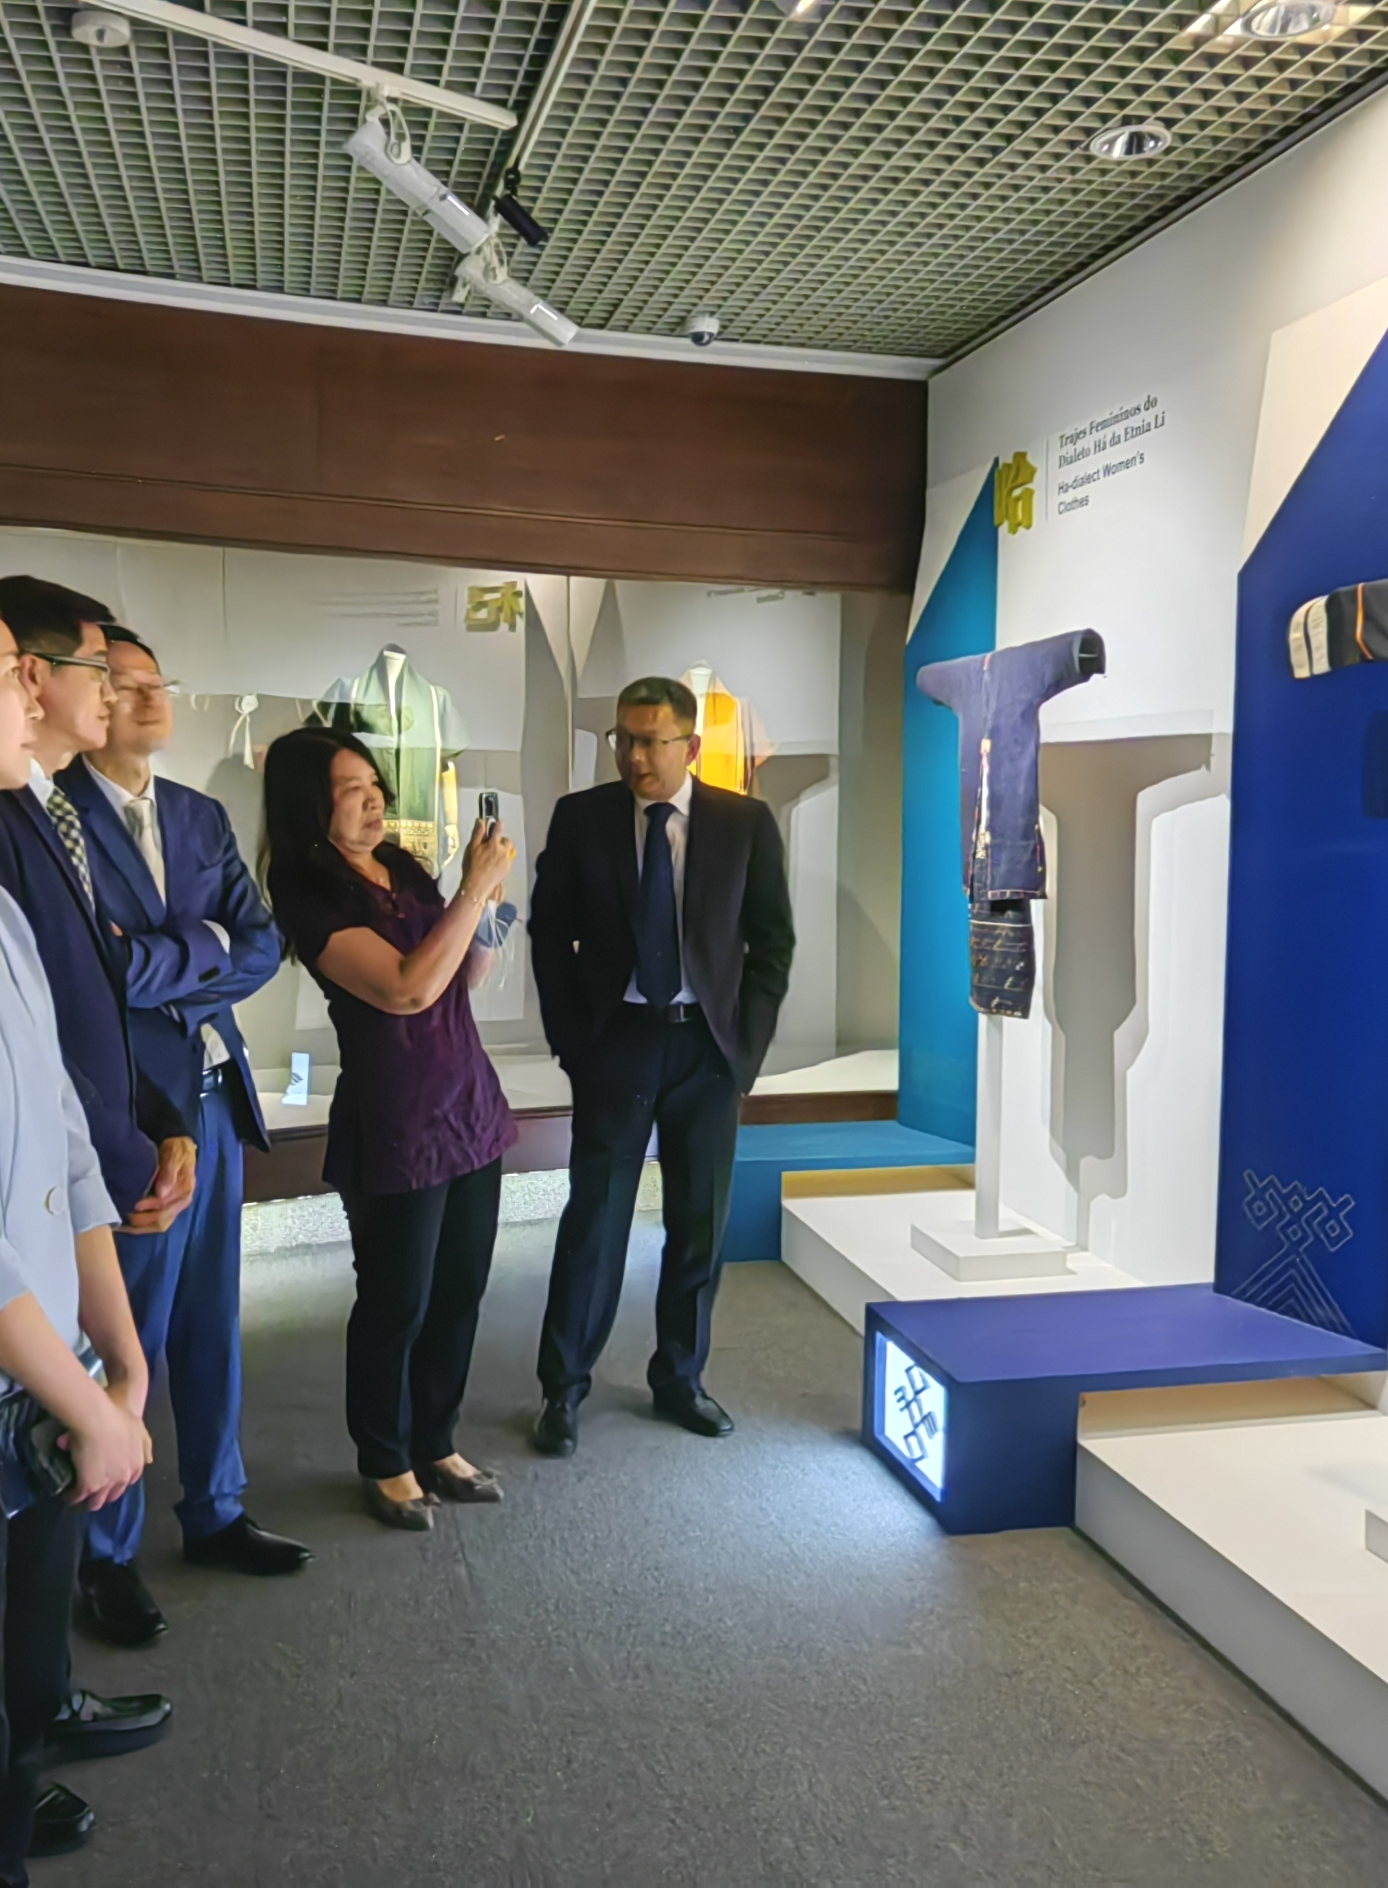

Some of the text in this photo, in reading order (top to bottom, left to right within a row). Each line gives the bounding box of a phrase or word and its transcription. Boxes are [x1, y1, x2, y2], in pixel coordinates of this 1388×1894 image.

[1058, 394, 1159, 450] Trajes Femininos do
[1058, 410, 1166, 470] Dialeto Há da Etnia Li
[1057, 450, 1145, 496] Ha-dialect Women's
[1057, 495, 1090, 515] Clothes
